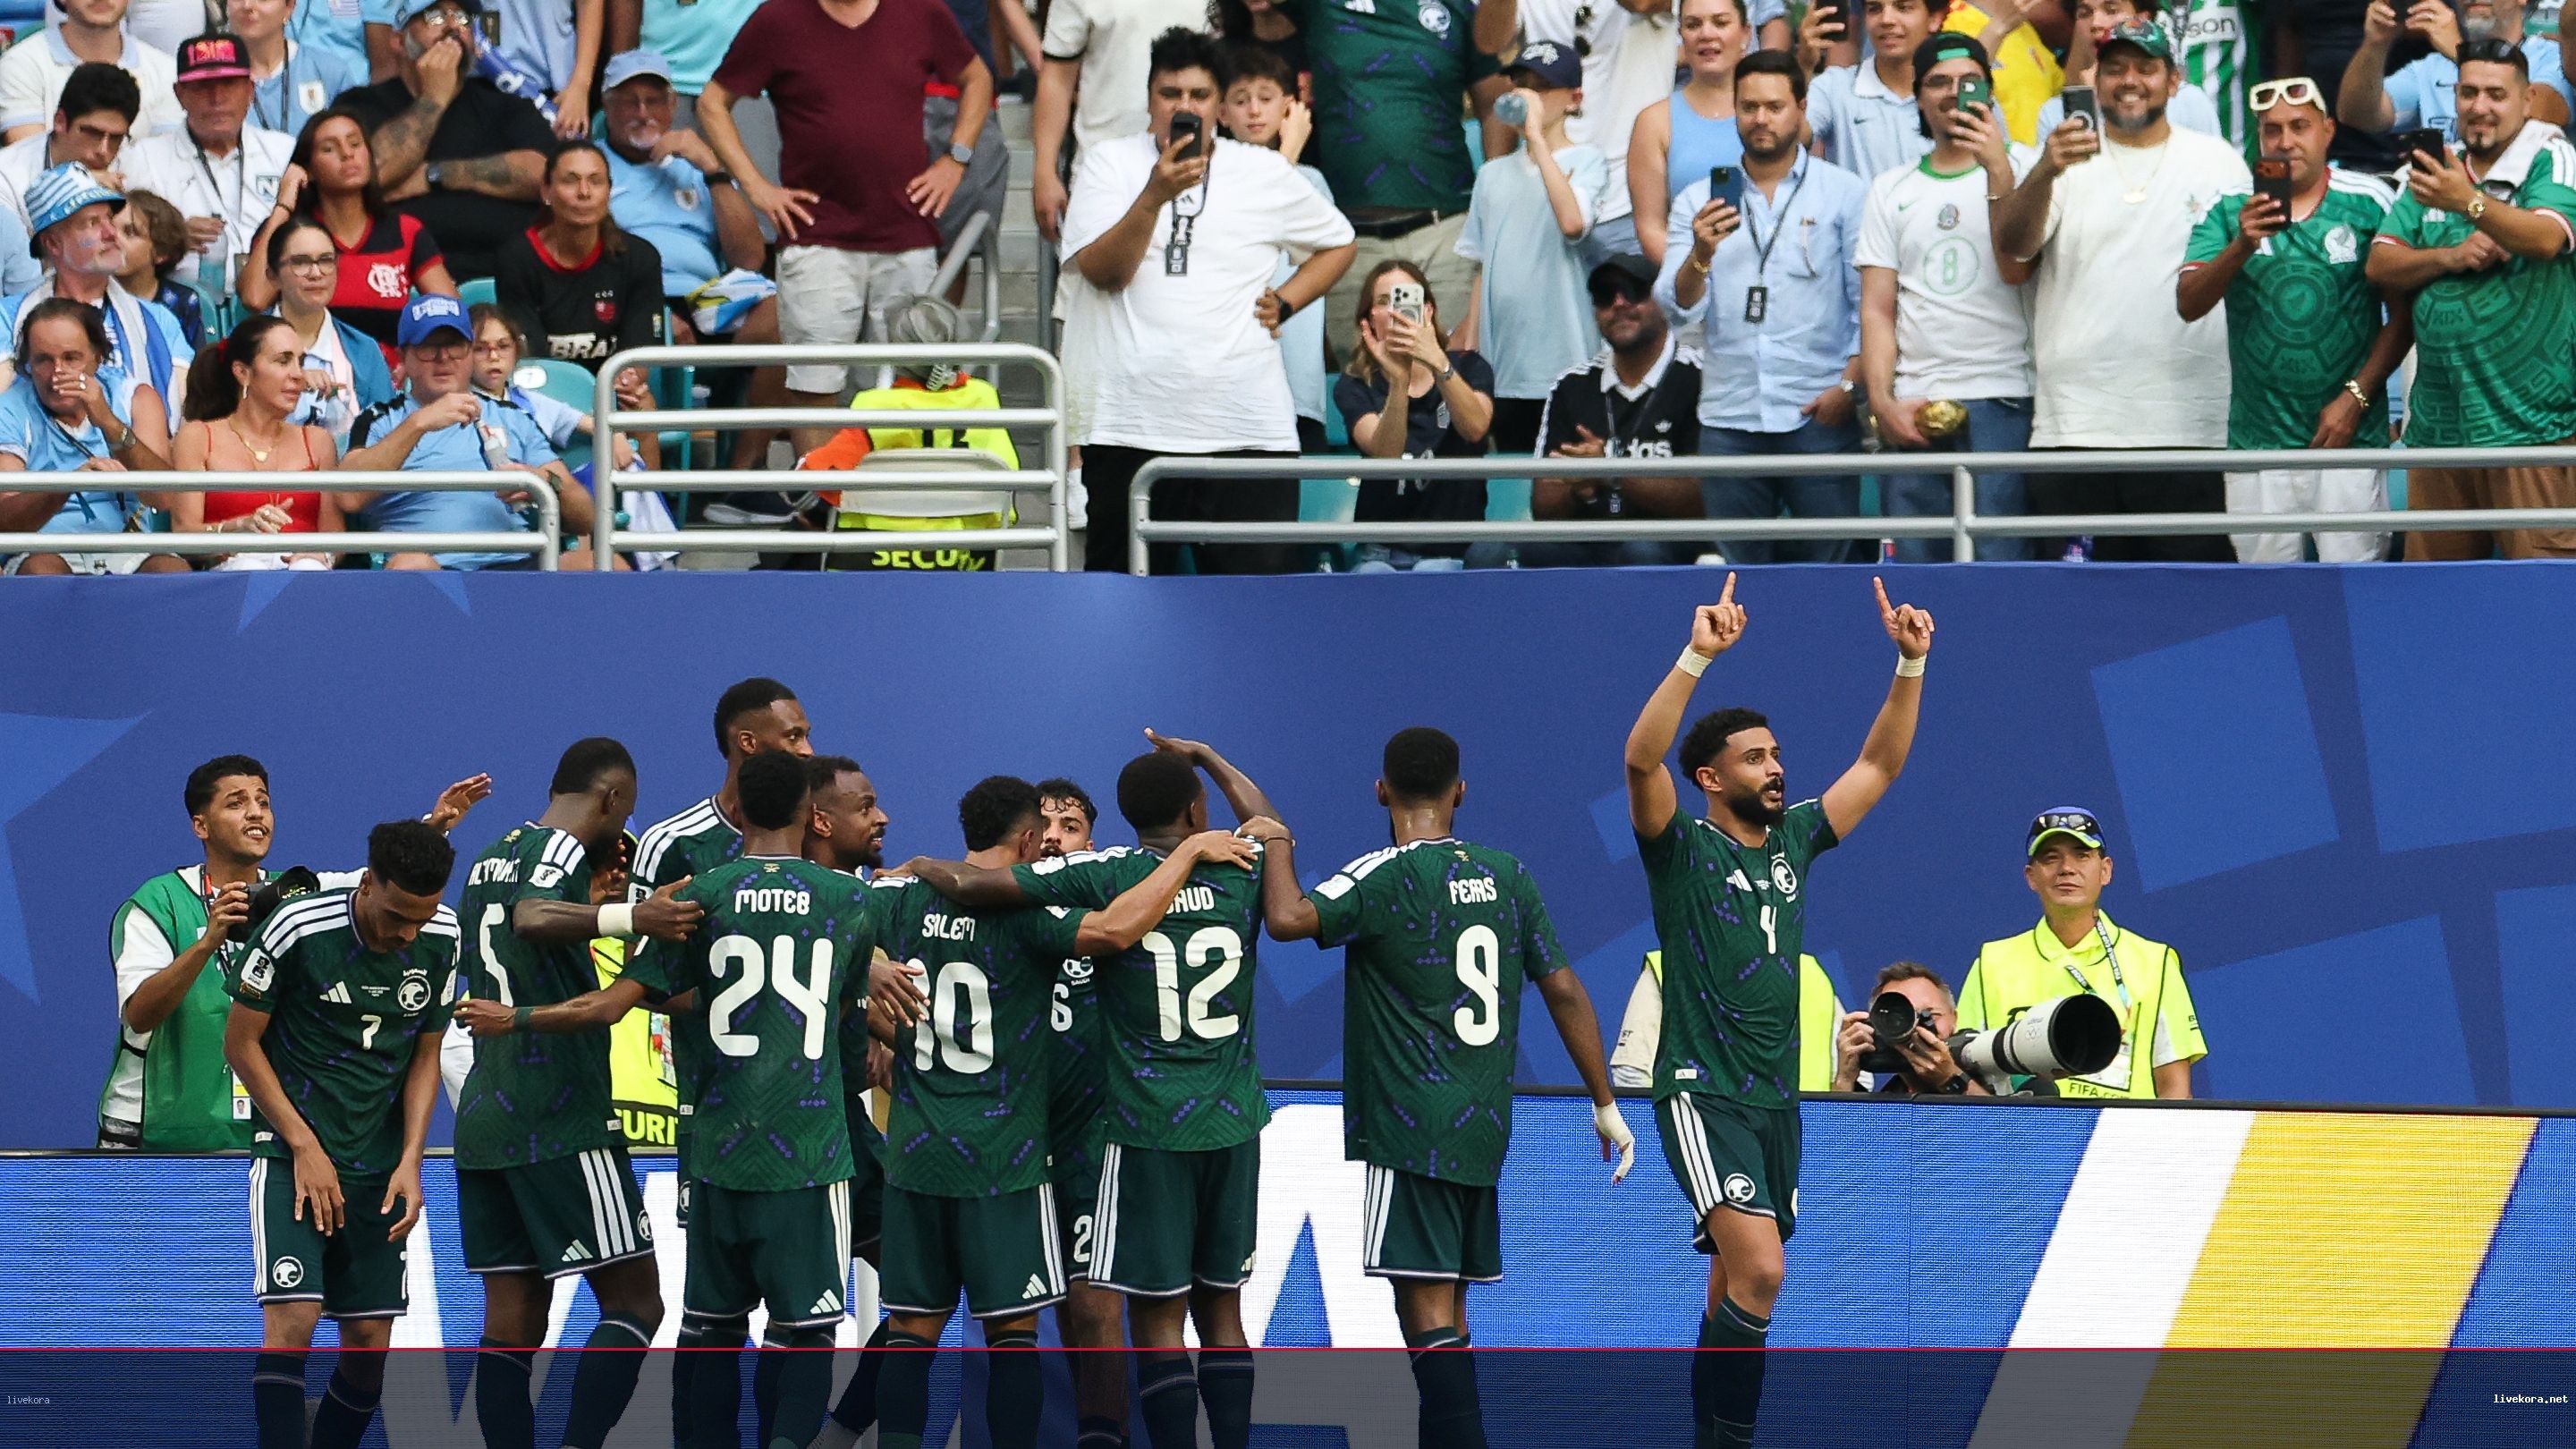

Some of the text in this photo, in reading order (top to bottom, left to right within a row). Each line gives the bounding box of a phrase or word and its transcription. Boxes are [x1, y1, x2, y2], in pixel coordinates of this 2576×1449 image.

[547, 332, 617, 359] BRA
[734, 888, 810, 915] MOTEB
[1760, 905, 1777, 954] 4
[709, 934, 834, 1061] 24
[905, 958, 994, 1074] 10
[1142, 926, 1243, 1042] 12
[1454, 924, 1500, 1046] 9
[360, 1014, 382, 1050] 7
